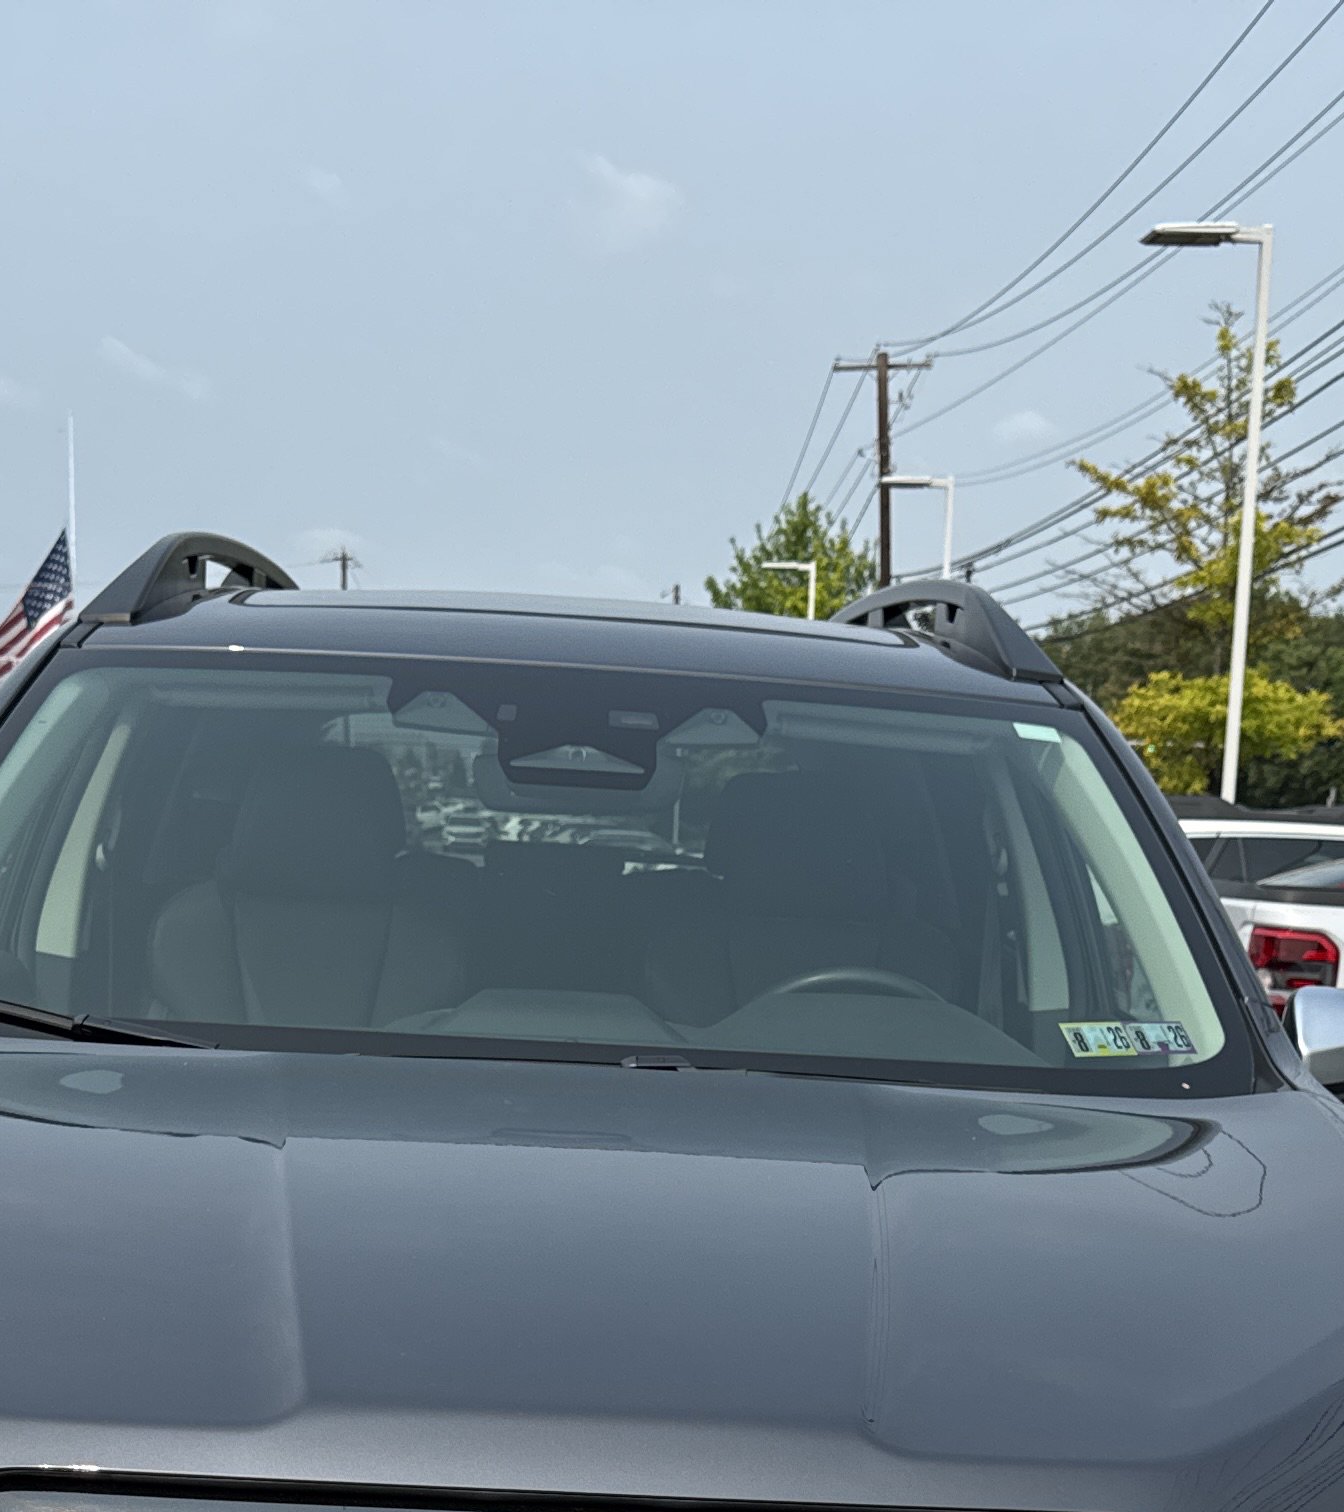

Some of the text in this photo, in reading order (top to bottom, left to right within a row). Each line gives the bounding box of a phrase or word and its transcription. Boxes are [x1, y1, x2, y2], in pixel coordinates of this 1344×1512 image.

[1073, 1026, 1131, 1052] 8 26
[1134, 1025, 1193, 1051] 8 26
